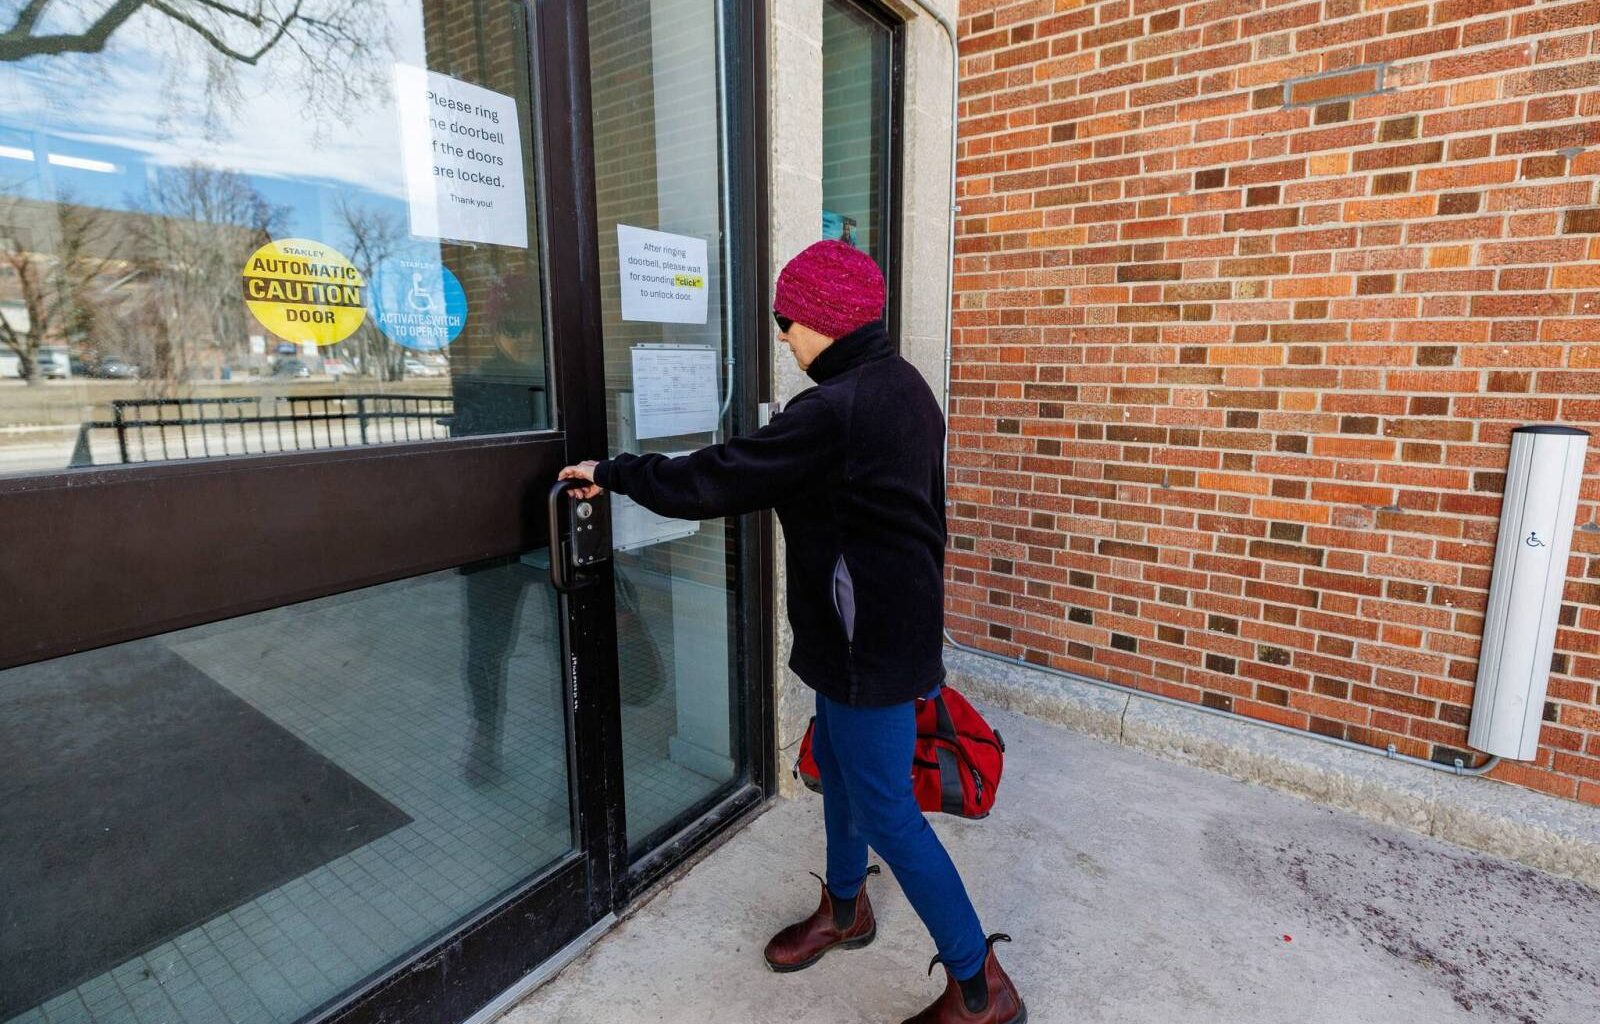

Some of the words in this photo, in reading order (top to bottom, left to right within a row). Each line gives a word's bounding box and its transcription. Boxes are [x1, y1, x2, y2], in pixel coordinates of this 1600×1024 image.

[475, 105, 499, 123] ring
[450, 122, 505, 145] doorbell
[440, 142, 464, 157] the
[467, 148, 504, 166] doors
[432, 165, 454, 178] are
[457, 168, 505, 188] locked.
[451, 194, 475, 206] Thank
[476, 200, 493, 208] you!
[283, 247, 324, 257] STANLEY
[643, 242, 661, 251] After
[663, 246, 686, 258] ringing
[252, 258, 356, 280] AUTOMATIC
[628, 256, 660, 269] doorbell,
[662, 262, 686, 271] please
[629, 272, 640, 281] for
[641, 274, 675, 286] sounding
[248, 279, 360, 304] CAUTION
[640, 289, 648, 297] to
[650, 290, 673, 299] unlock
[286, 309, 335, 323] DOOR
[380, 313, 424, 325] ACTIVATE
[425, 314, 460, 326] SWITCH
[394, 325, 407, 336] TO
[409, 326, 449, 338] OPERATE
